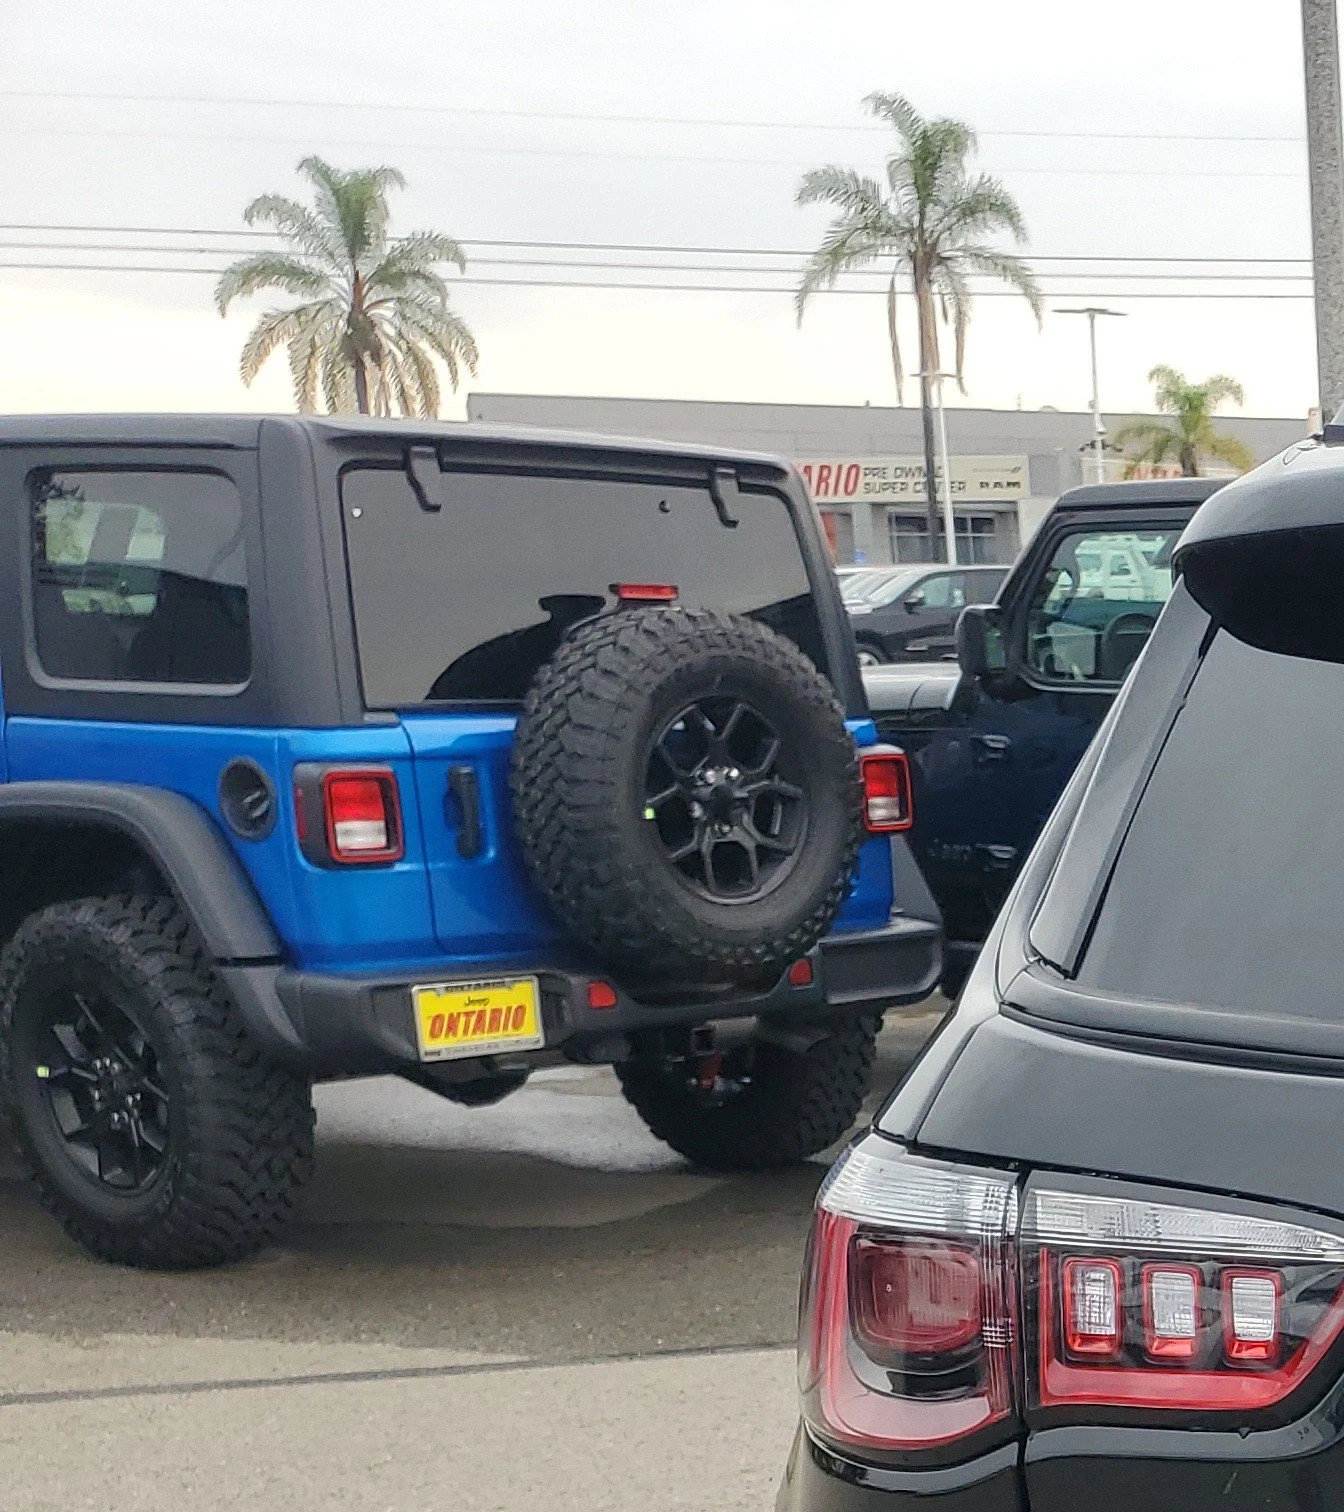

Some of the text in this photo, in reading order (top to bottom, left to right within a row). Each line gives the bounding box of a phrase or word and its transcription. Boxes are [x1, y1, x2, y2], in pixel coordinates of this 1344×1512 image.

[803, 463, 861, 497] ARIO
[894, 465, 944, 478] OWND
[429, 1005, 527, 1039] ONTARIO
